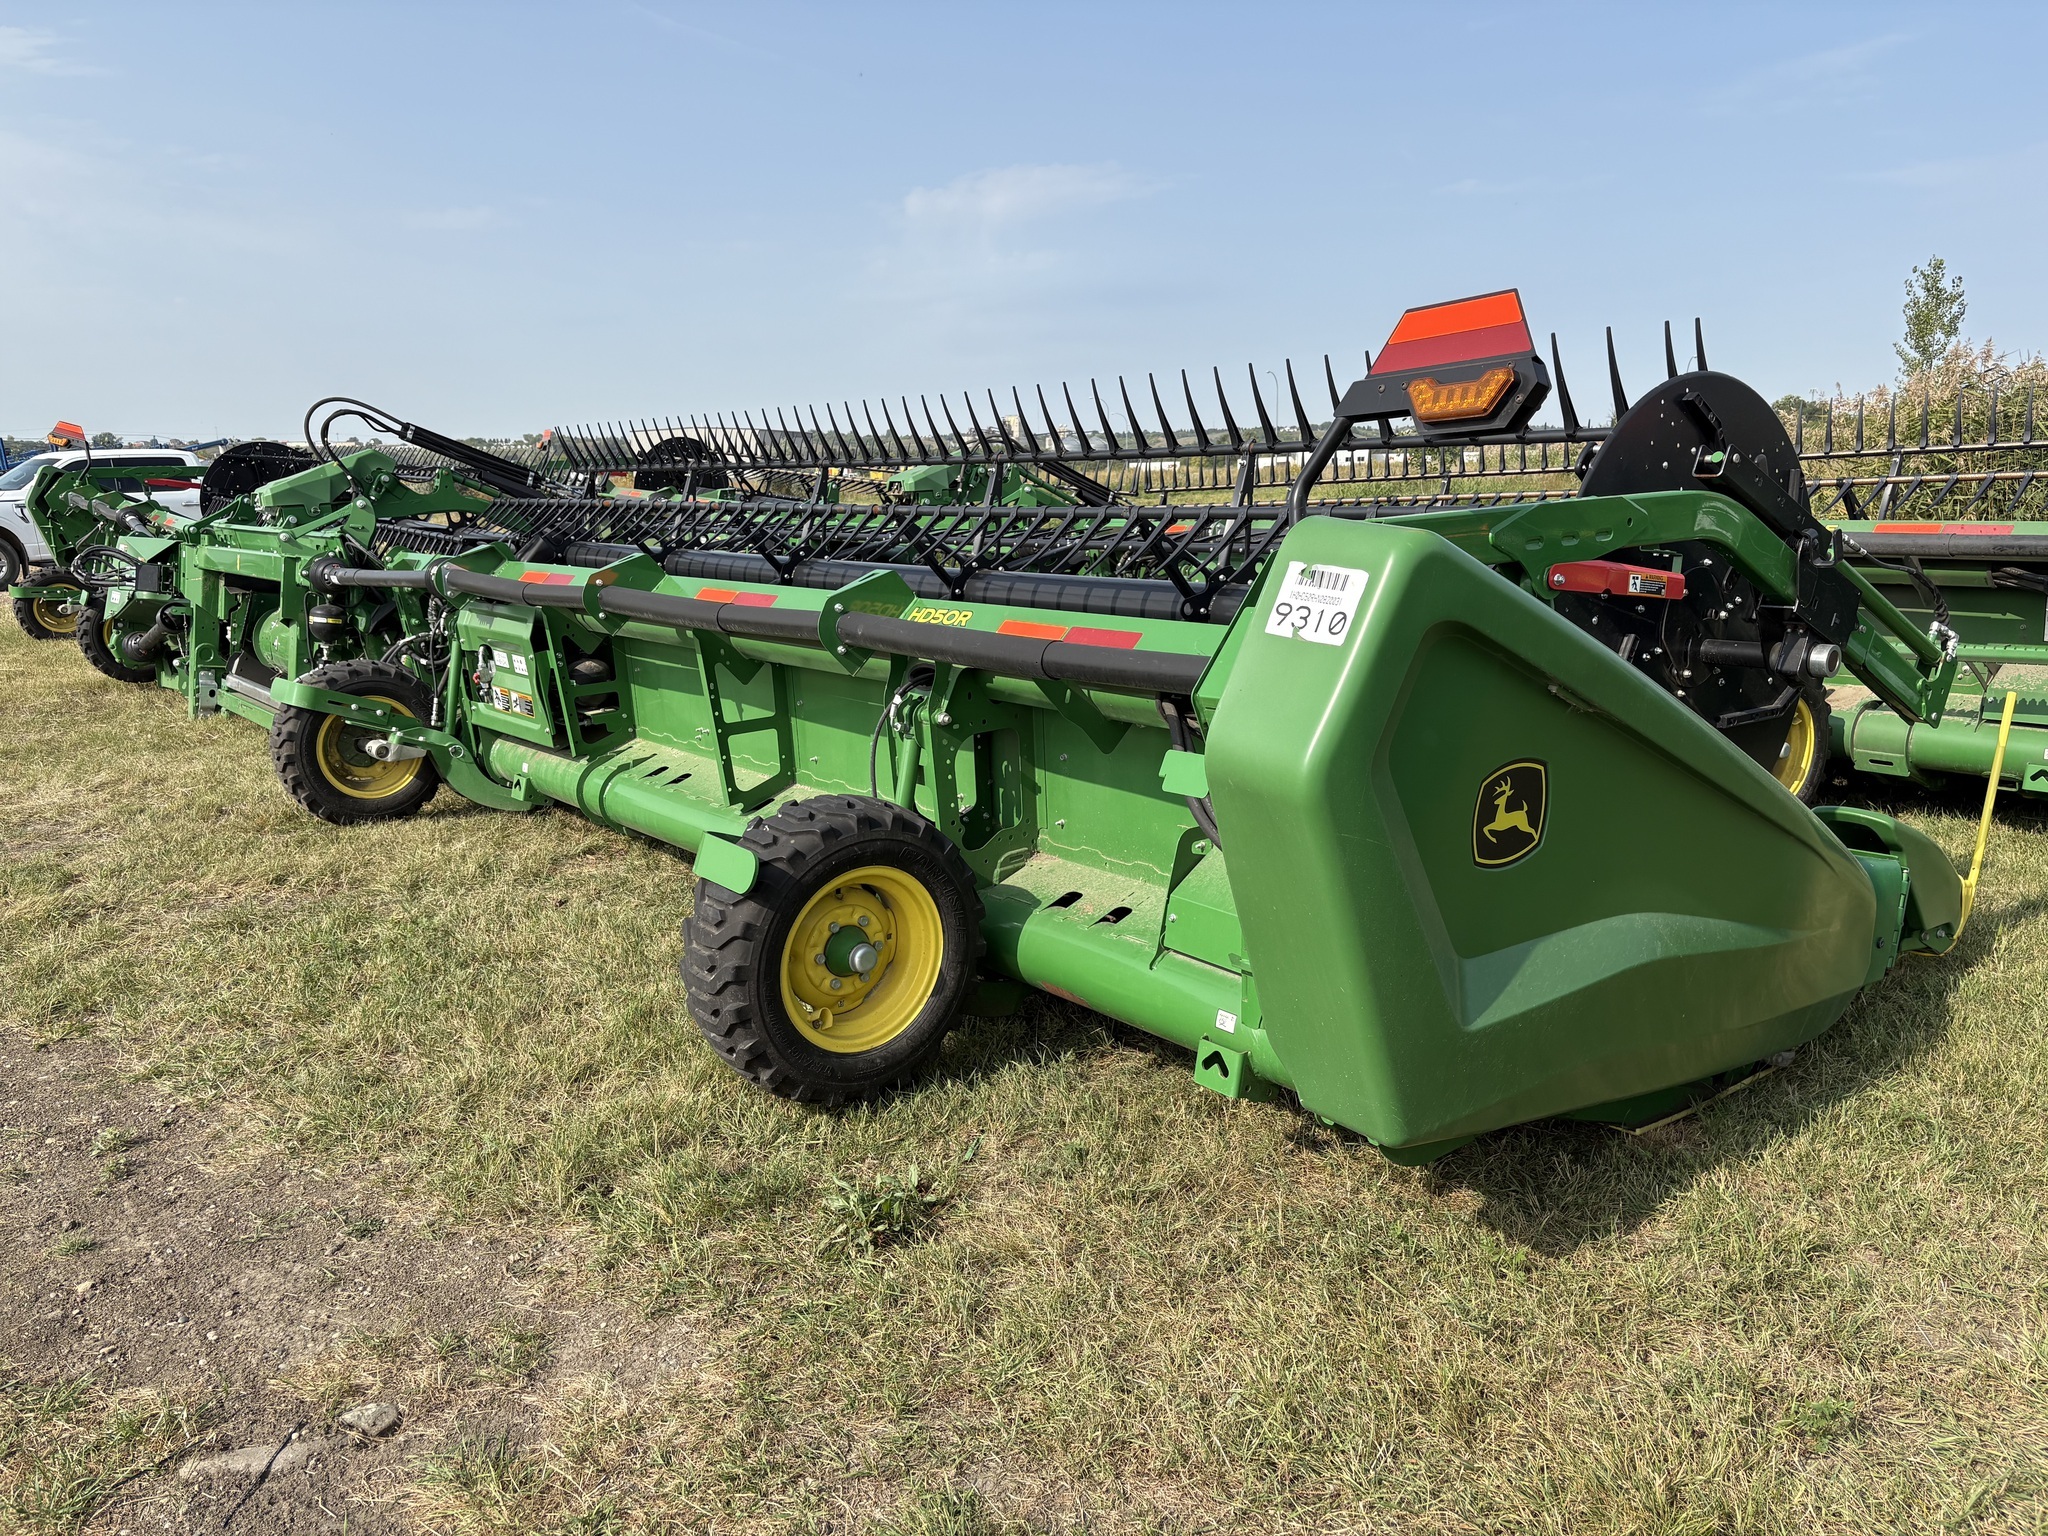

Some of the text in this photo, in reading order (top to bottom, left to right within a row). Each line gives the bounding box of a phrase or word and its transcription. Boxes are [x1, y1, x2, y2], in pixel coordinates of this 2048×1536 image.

[907, 607, 974, 628] HD50R
[1275, 602, 1348, 636] 9310
[898, 846, 968, 943] CARLISLE
